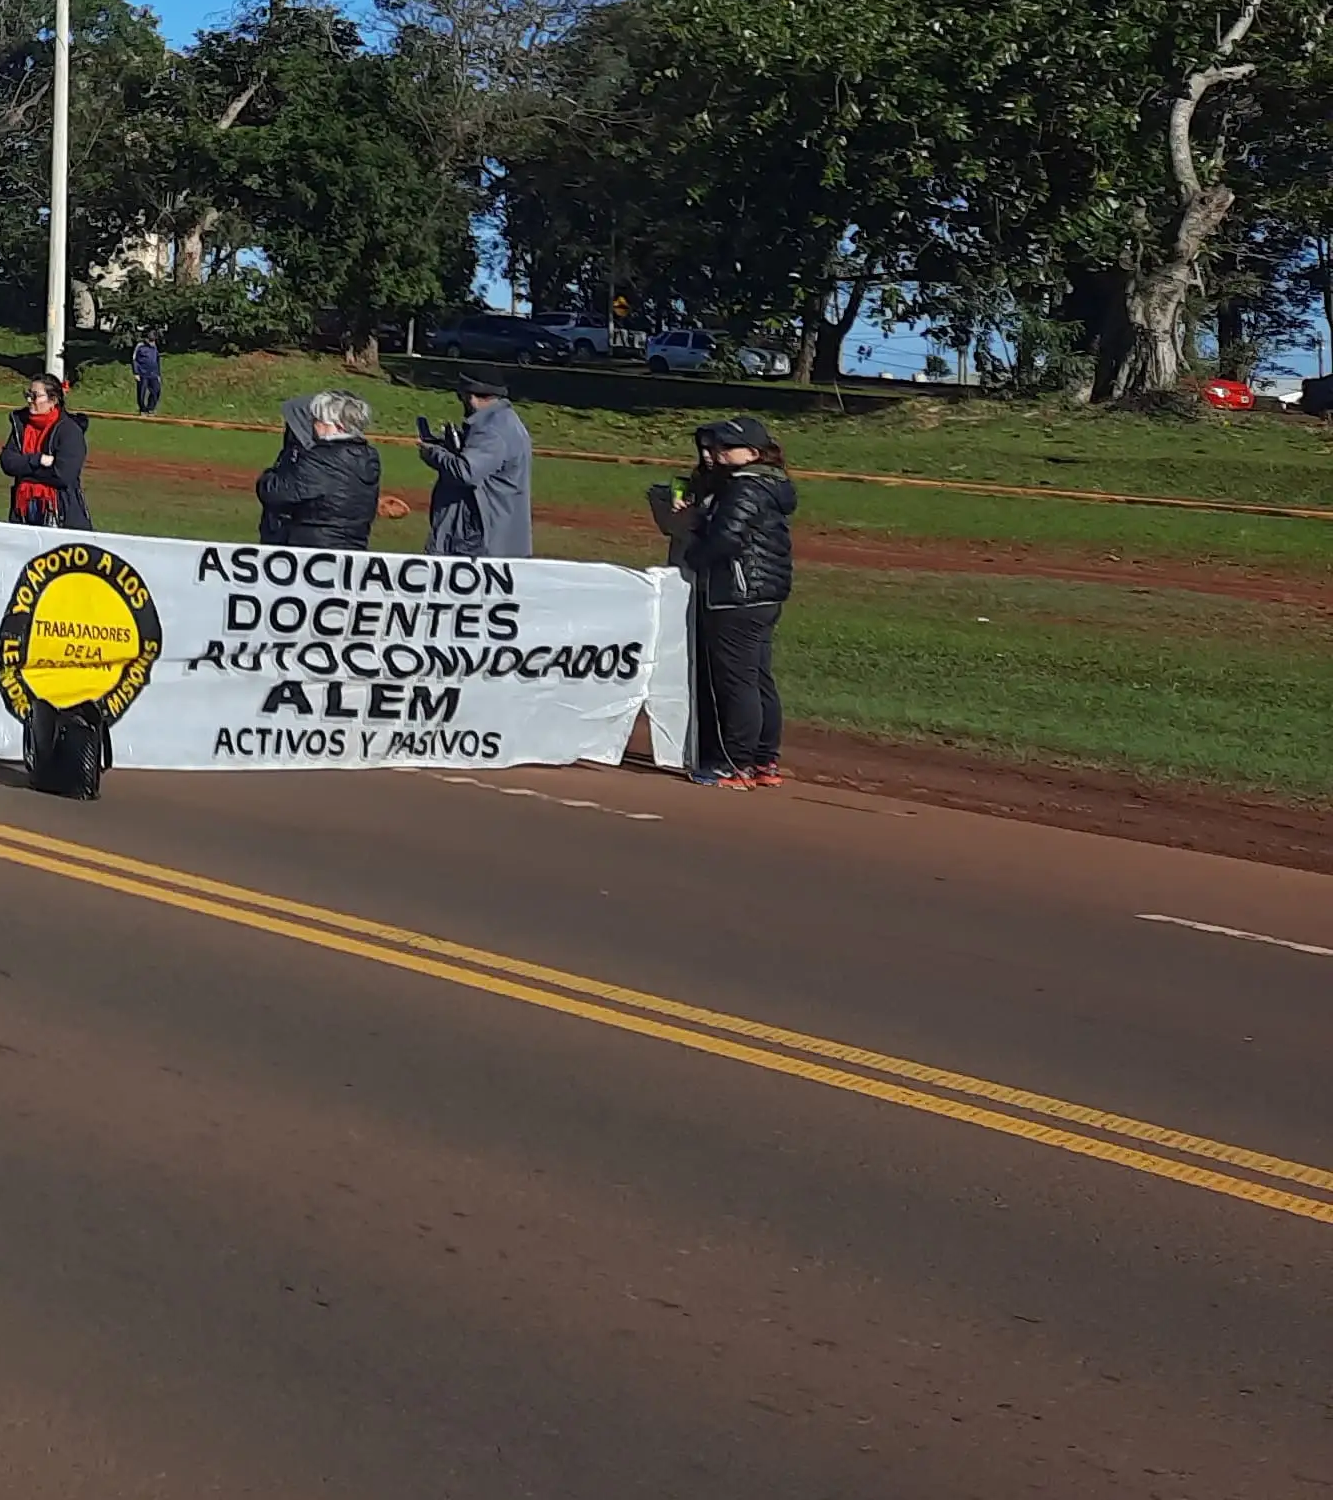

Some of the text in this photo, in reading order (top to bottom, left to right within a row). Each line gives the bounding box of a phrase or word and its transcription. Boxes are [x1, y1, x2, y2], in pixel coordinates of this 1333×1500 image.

[12, 547, 148, 614] YO APOYO A LOS
[36, 620, 131, 643] TRABAJADORES
[227, 593, 520, 641] DOCENTES
[64, 643, 102, 660] DE LA
[187, 640, 643, 680] AUTOCONVOCADOS
[262, 680, 461, 722] ALEM
[214, 728, 502, 758] ACTIVOS Y PASIVOS
